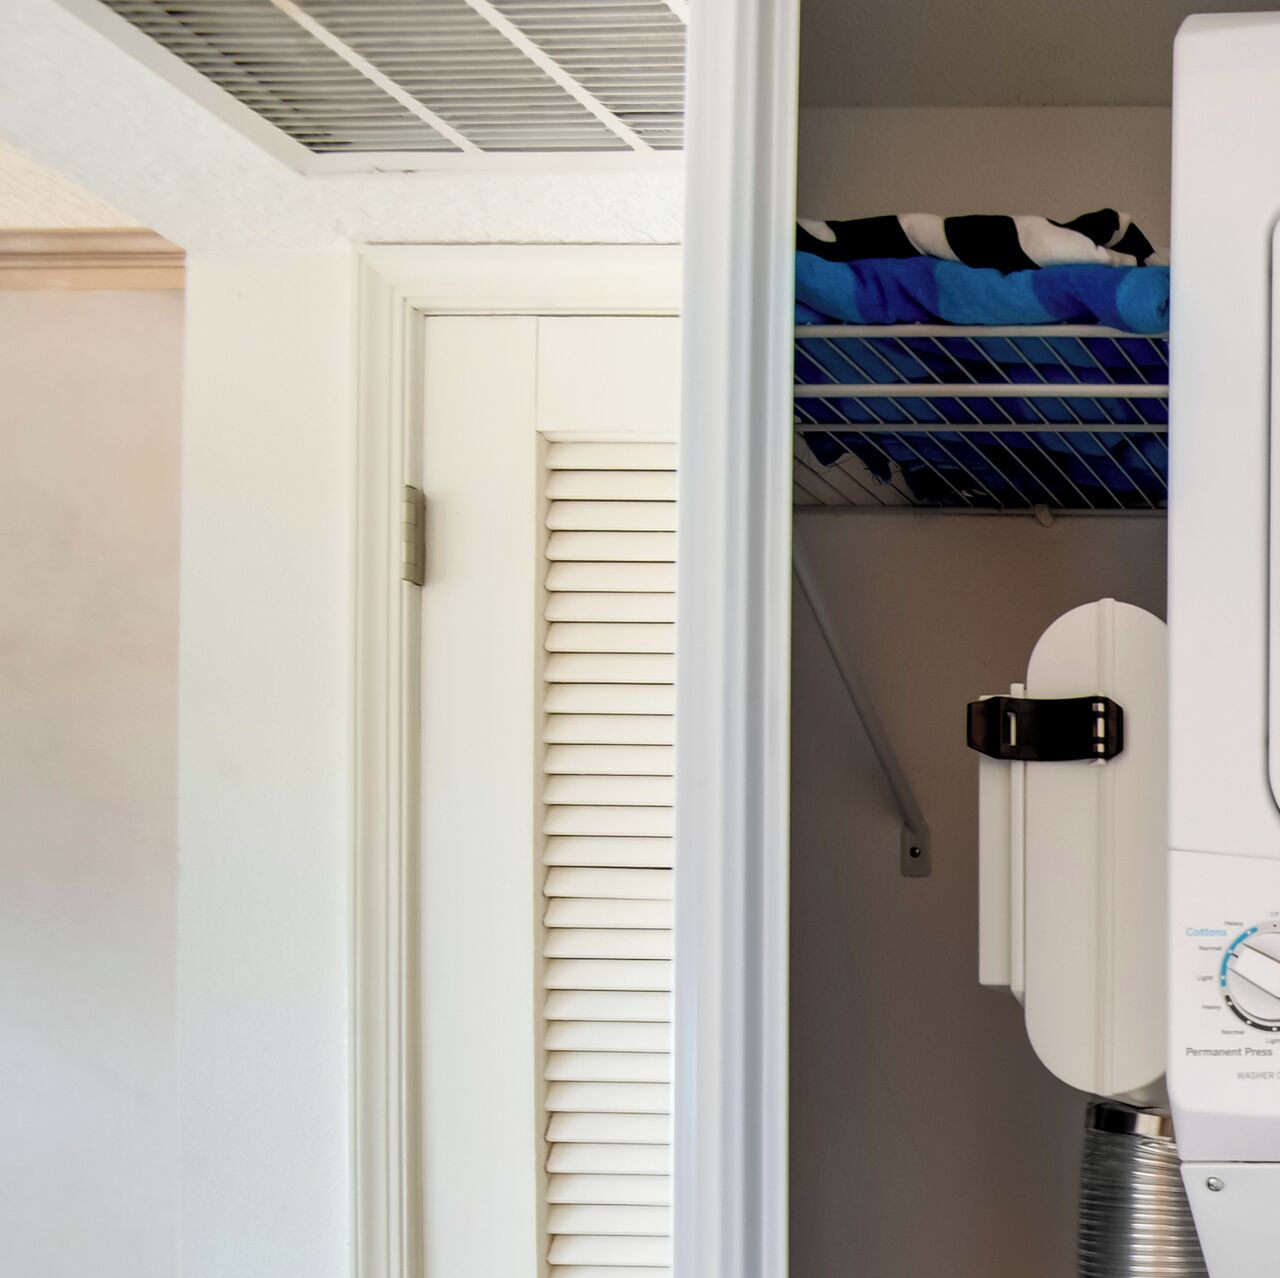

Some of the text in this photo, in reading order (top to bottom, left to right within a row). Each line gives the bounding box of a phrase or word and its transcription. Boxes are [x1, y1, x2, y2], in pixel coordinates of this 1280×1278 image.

[1185, 927, 1228, 937] Cottons
[1185, 1047, 1274, 1057] Permanent Press
[1236, 1071, 1275, 1080] WASHER
